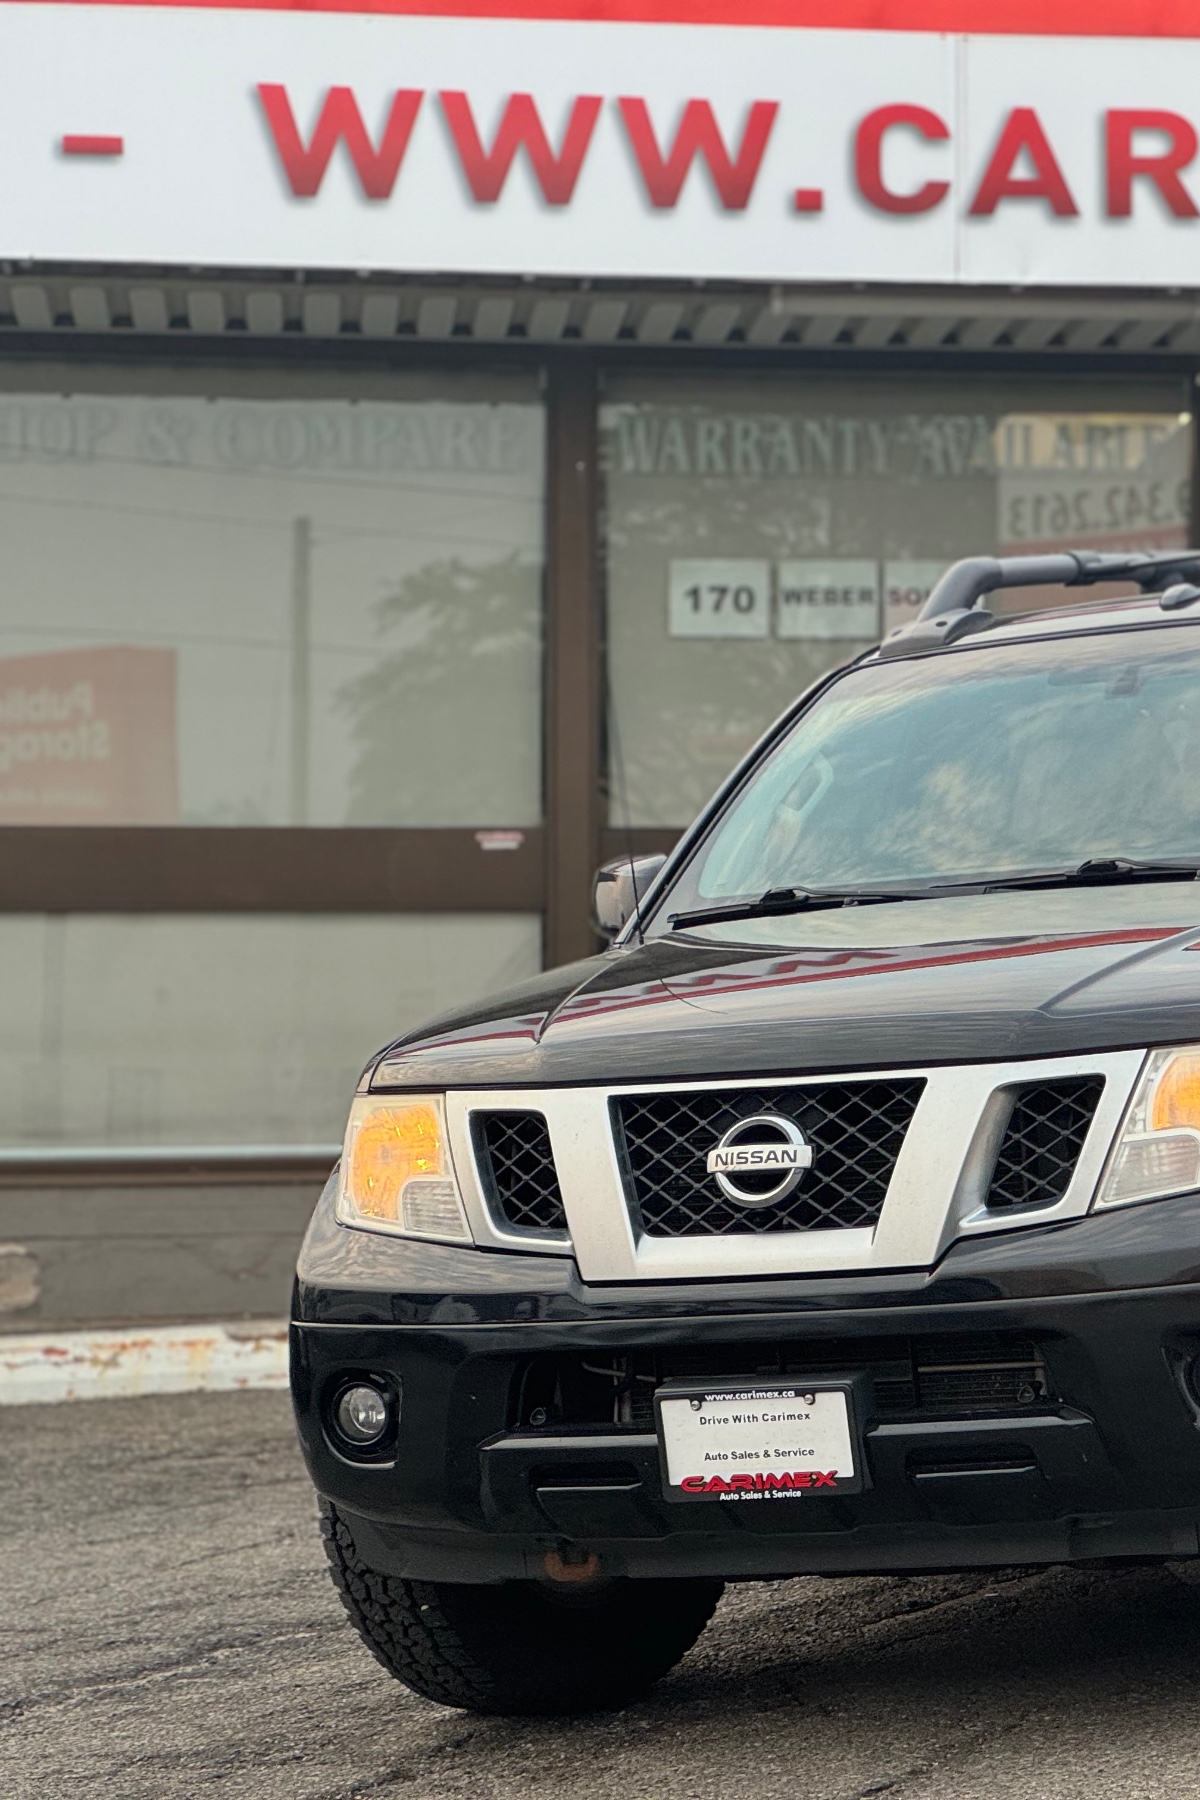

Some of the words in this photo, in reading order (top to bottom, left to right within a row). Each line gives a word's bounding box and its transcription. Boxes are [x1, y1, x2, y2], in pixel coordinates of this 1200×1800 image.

[213, 410, 528, 475] COMPARE
[616, 414, 901, 475] WARRANTY
[685, 584, 756, 614] 170
[783, 587, 873, 606] WEBER
[715, 1149, 797, 1167] NISSAN
[705, 1390, 795, 1402] www.carimex.ca
[700, 1414, 729, 1426] Drive
[732, 1413, 759, 1424] With
[762, 1411, 811, 1423] Carimex
[704, 1451, 729, 1462] Auto
[731, 1449, 760, 1461] Sales
[763, 1449, 771, 1459] &
[774, 1447, 815, 1458] Service
[680, 1470, 839, 1492] CARIMEX
[719, 1491, 739, 1501] Auto
[740, 1490, 763, 1500] Sales
[764, 1490, 771, 1499] &
[772, 1488, 802, 1499] Service
